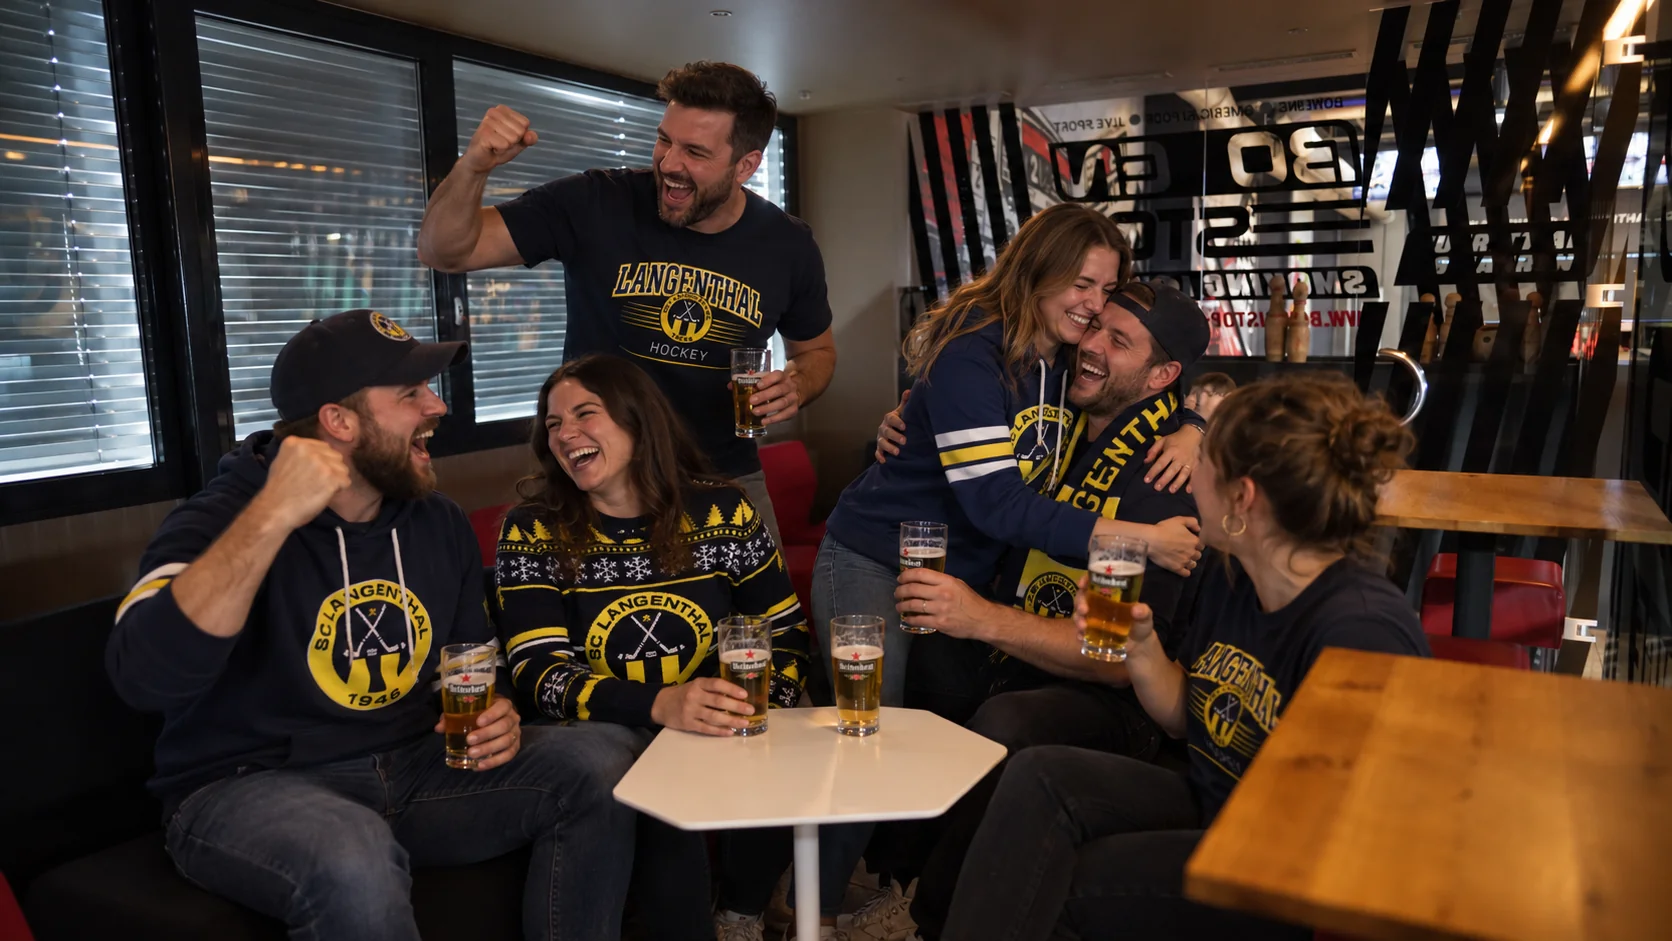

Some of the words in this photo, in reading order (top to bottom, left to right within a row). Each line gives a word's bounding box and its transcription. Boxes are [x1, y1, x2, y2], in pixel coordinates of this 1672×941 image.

[611, 262, 763, 328] LANGENTHAL
[650, 341, 708, 361] HOCKEY
[323, 584, 428, 640] LANGENTHAL
[589, 635, 603, 660] SC
[597, 595, 710, 643] LANGENTHAL
[348, 688, 401, 706] 1946
